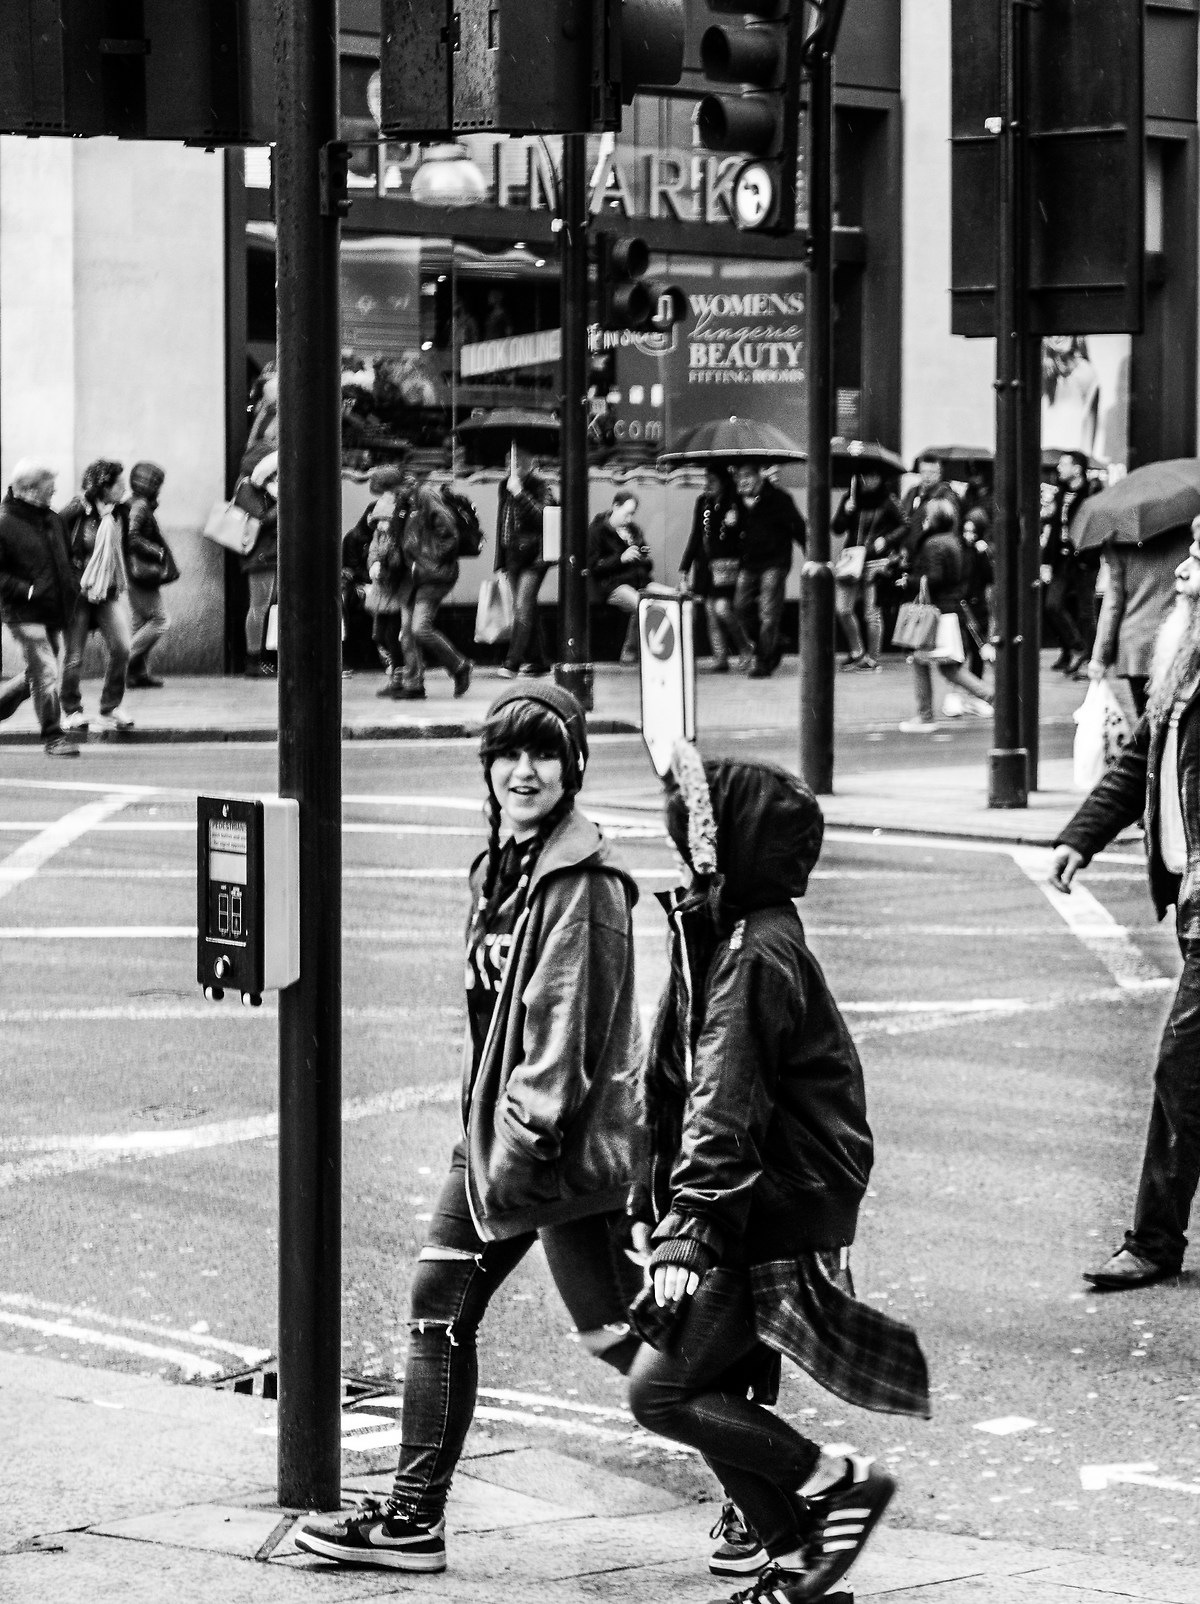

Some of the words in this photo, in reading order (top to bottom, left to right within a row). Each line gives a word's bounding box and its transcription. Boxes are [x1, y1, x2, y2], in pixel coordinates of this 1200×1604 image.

[377, 141, 739, 224] PIMARK
[688, 292, 805, 318] WOMENS
[687, 309, 804, 347] lingerie
[509, 328, 562, 368] ONLINE
[688, 340, 804, 369] BEAUTY
